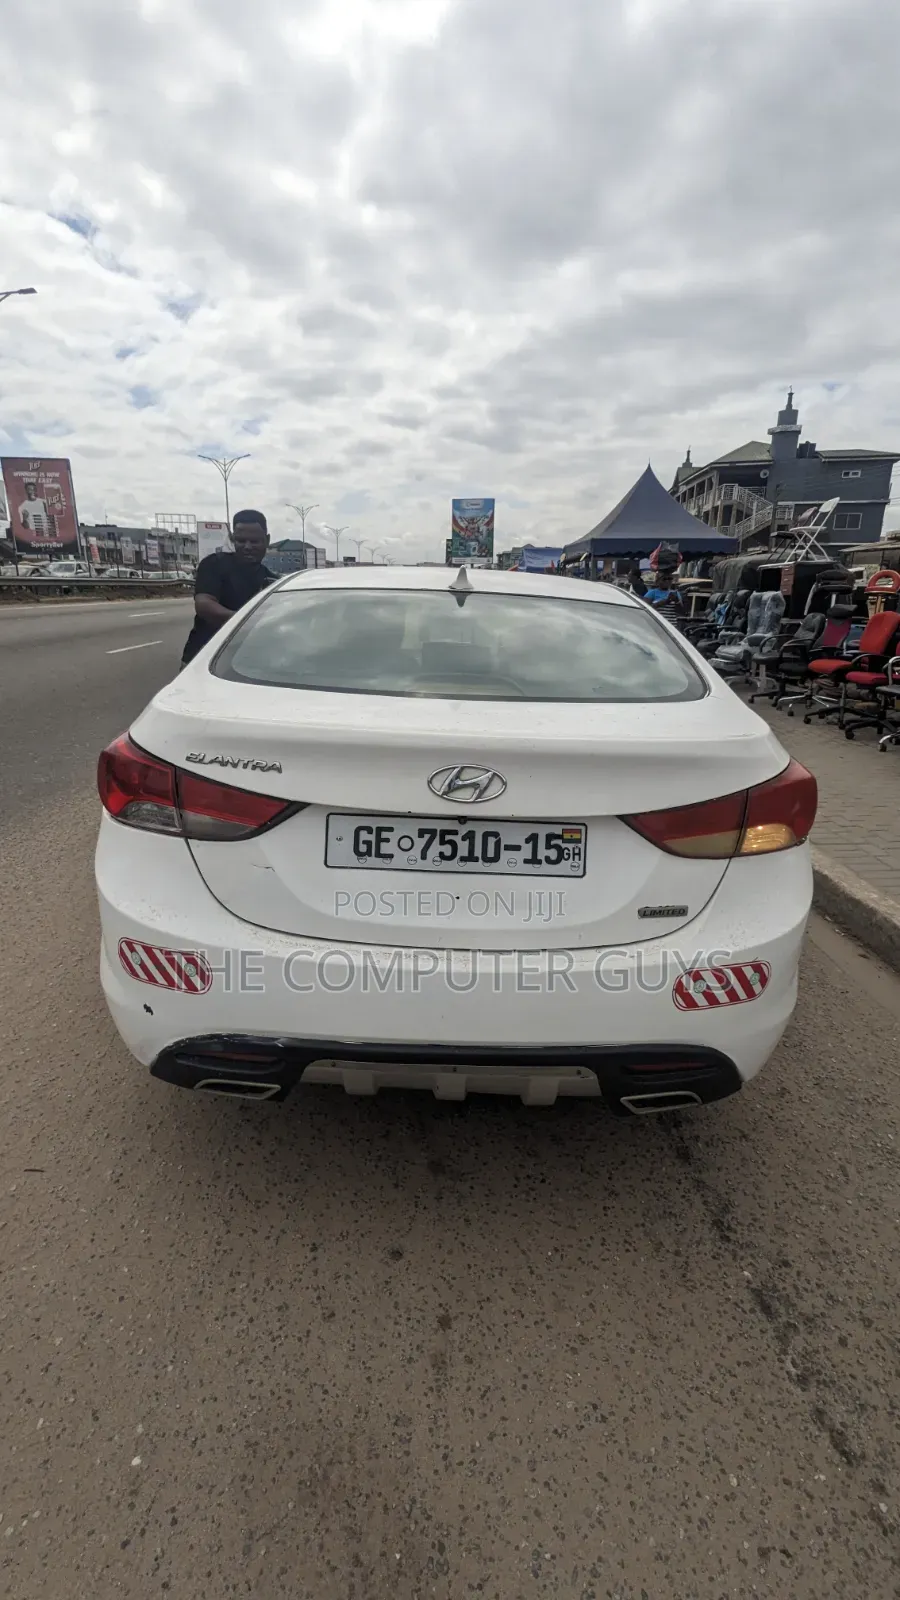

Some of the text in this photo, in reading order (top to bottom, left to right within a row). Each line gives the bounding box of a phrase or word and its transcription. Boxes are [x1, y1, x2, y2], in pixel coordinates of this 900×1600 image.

[185, 752, 283, 774] ELANTRA
[353, 825, 564, 866] GE 7510-15
[562, 846, 582, 862] GH
[642, 908, 686, 917] LIMITED
